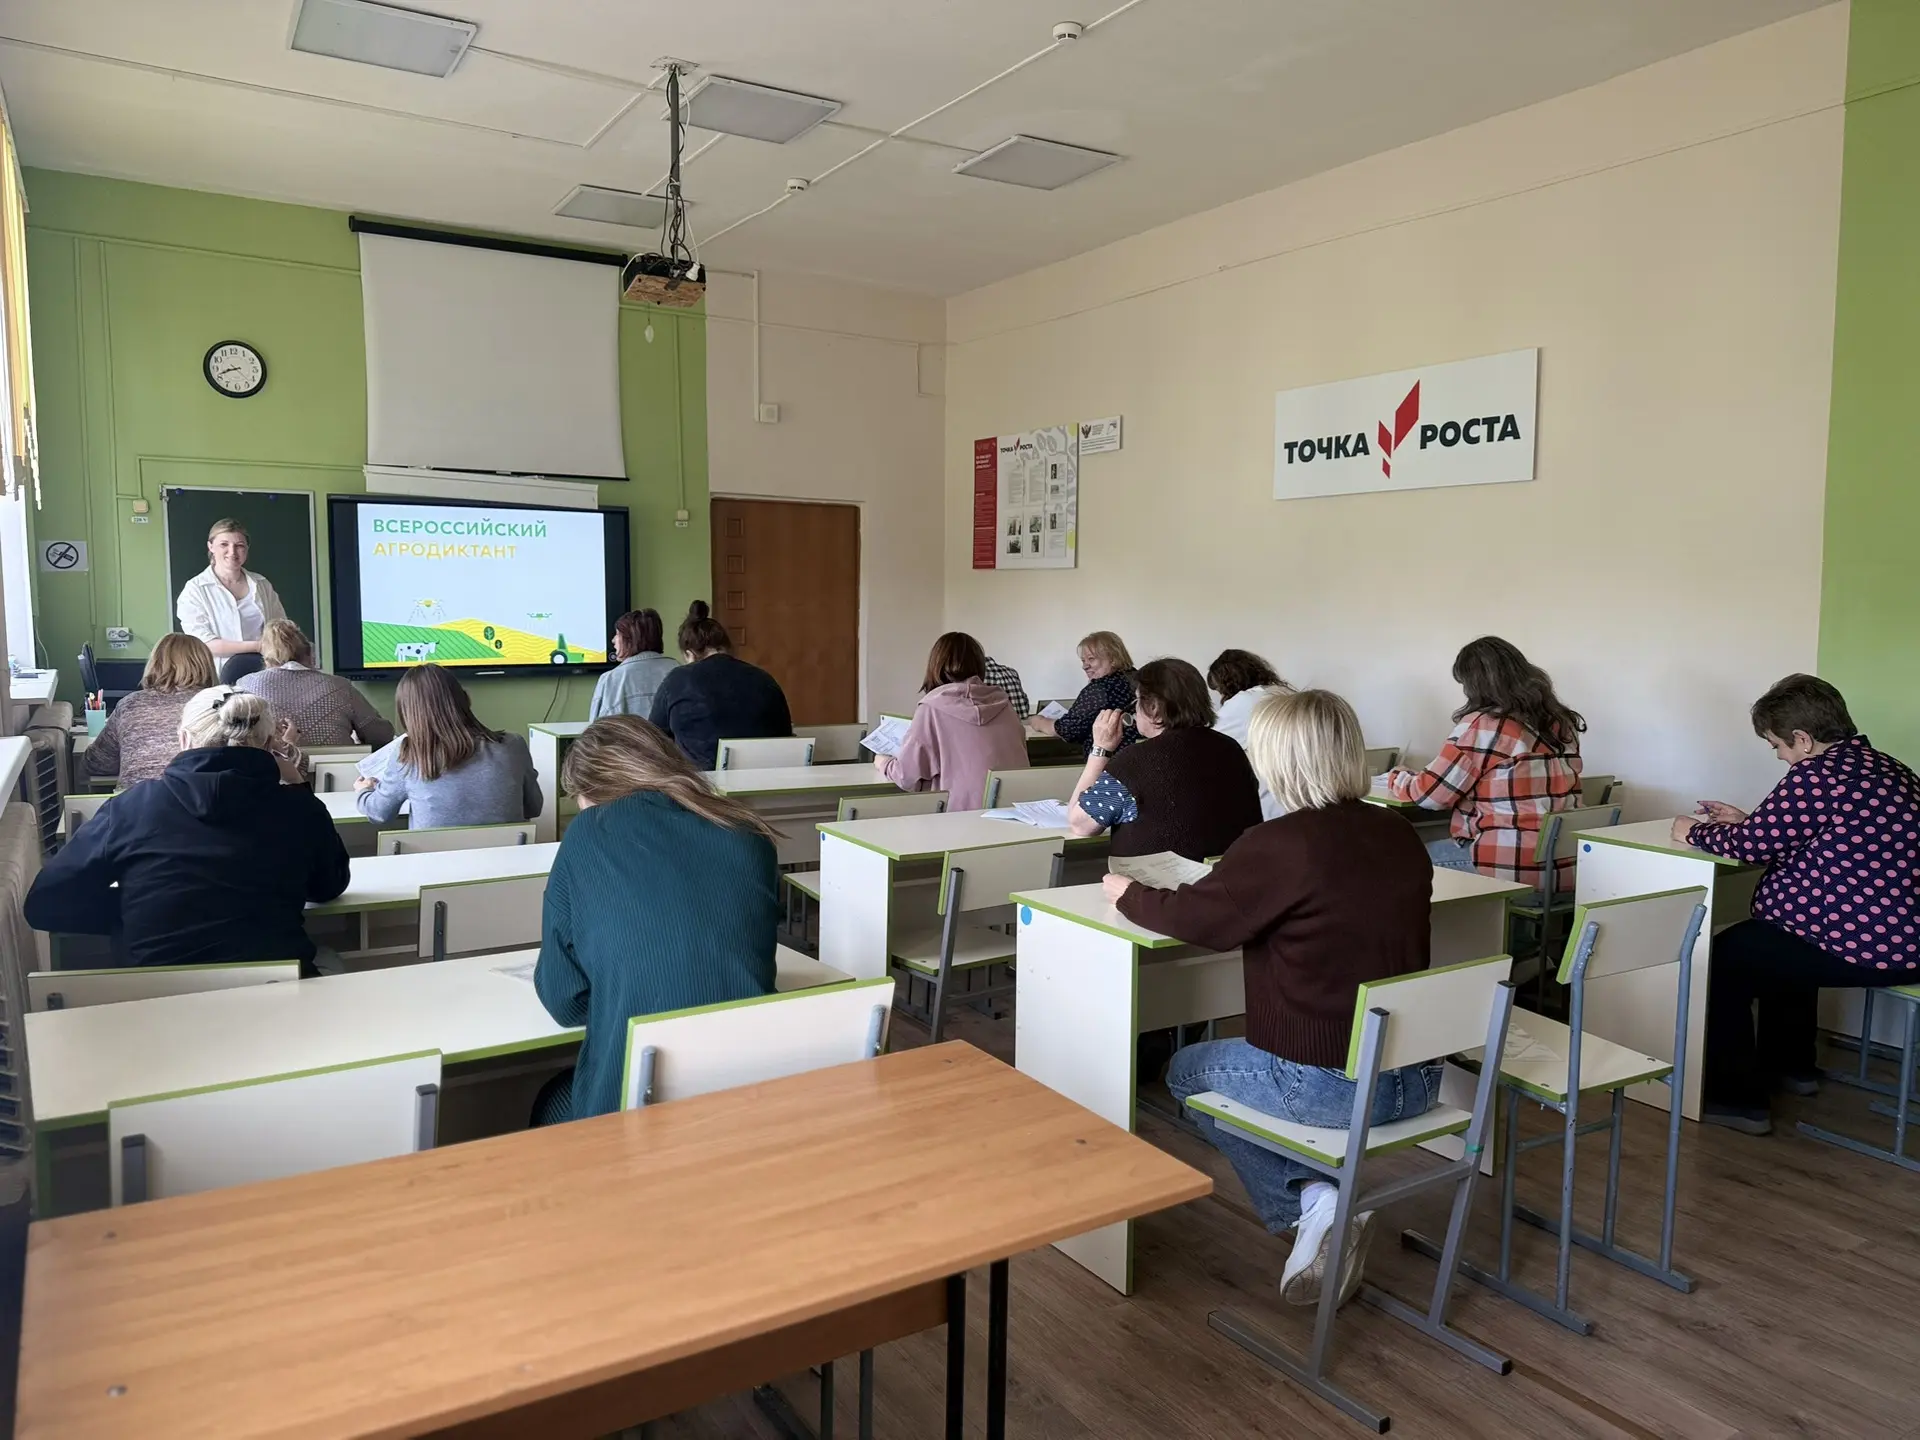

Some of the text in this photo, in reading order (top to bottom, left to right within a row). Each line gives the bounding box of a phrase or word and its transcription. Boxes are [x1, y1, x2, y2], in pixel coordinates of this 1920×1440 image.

[221, 349, 227, 357] 11
[229, 347, 238, 355] 12
[1284, 414, 1521, 464] ТОЧКА РОСТА
[373, 518, 547, 537] ВСЕРОССИЙСКИЙ
[373, 542, 517, 560] АГРОДИКТАНТ
